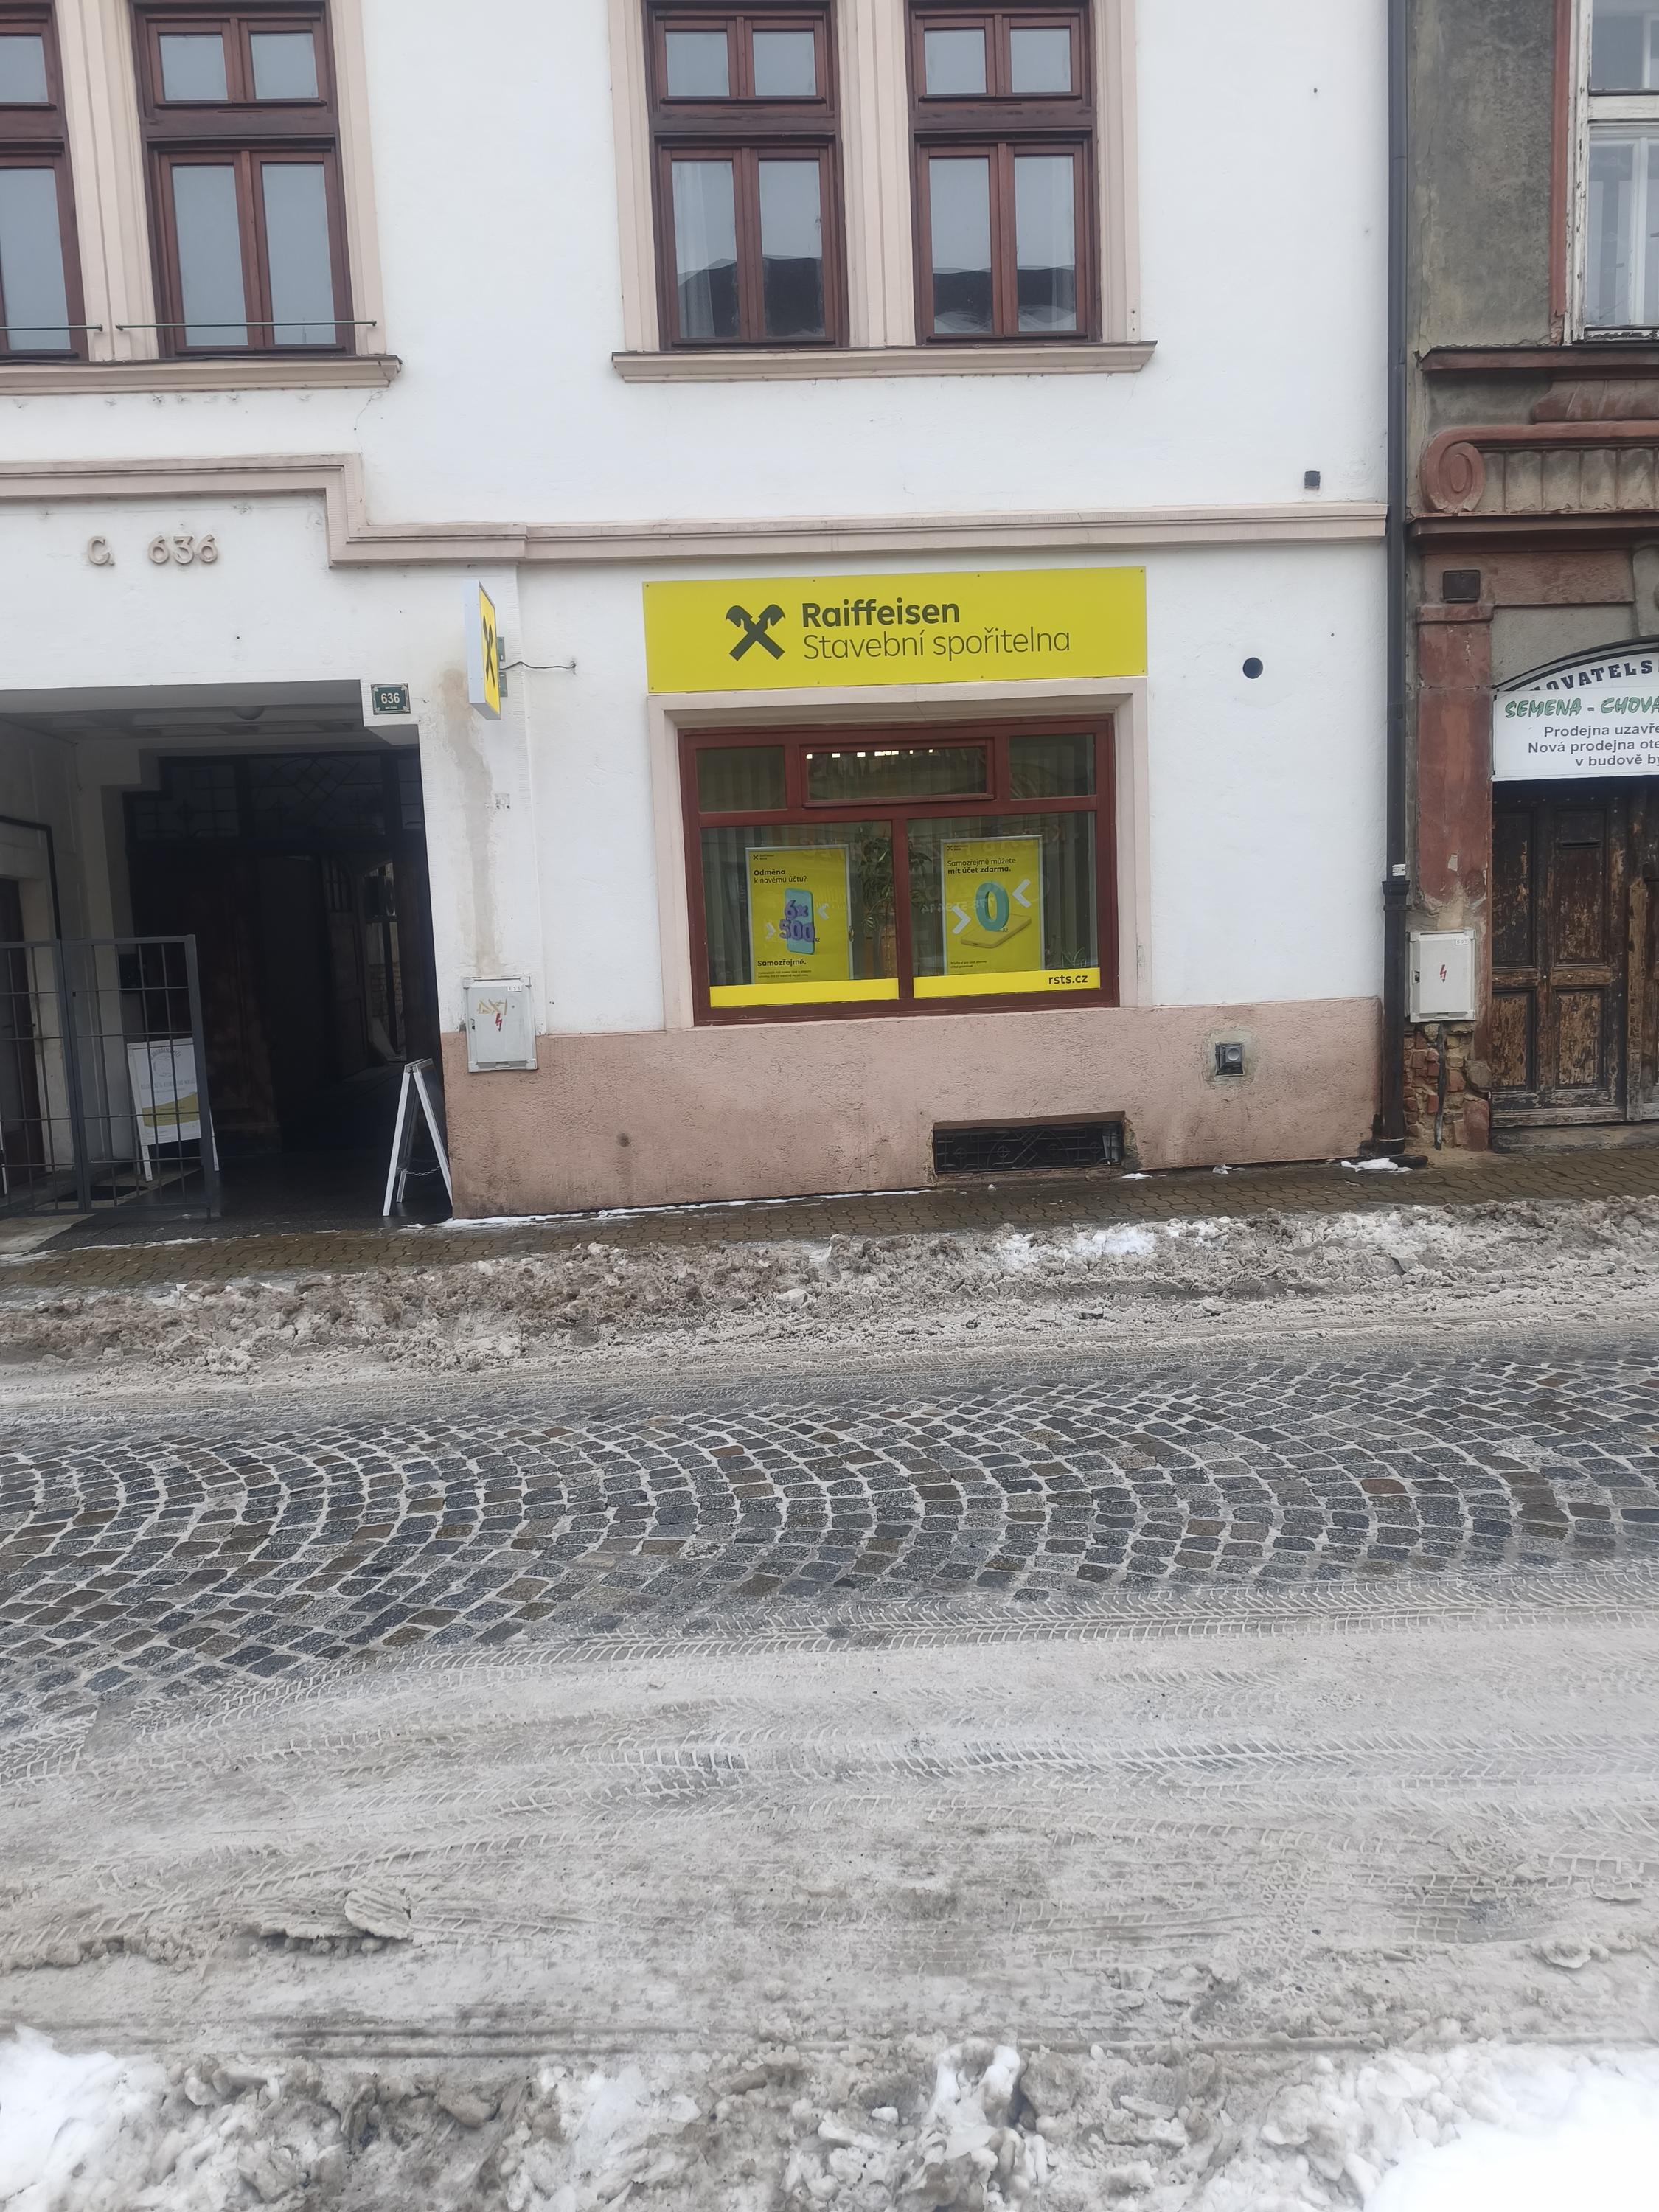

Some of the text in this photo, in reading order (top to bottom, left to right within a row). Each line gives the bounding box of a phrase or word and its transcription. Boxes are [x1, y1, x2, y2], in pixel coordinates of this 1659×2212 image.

[148, 534, 219, 565] 636
[801, 597, 960, 628] Raiffeisen
[803, 626, 1071, 661] Stavební spořitelna
[380, 692, 400, 704] 636
[1505, 698, 1582, 718] SEMENA
[1544, 726, 1610, 738] Prodejna
[1528, 742, 1565, 753] Nová
[1571, 740, 1635, 754] prodejna
[1575, 758, 1584, 766] v
[1589, 754, 1643, 766] budově
[947, 857, 1017, 867] Samozřejmě můžete
[759, 876, 787, 884] novému
[788, 874, 807, 883] účtu?
[784, 900, 809, 920] 6x
[975, 880, 1009, 932] 0
[779, 919, 816, 943] 500
[757, 959, 807, 967] Samozřejmě.
[1048, 975, 1088, 985] rsts.cz
